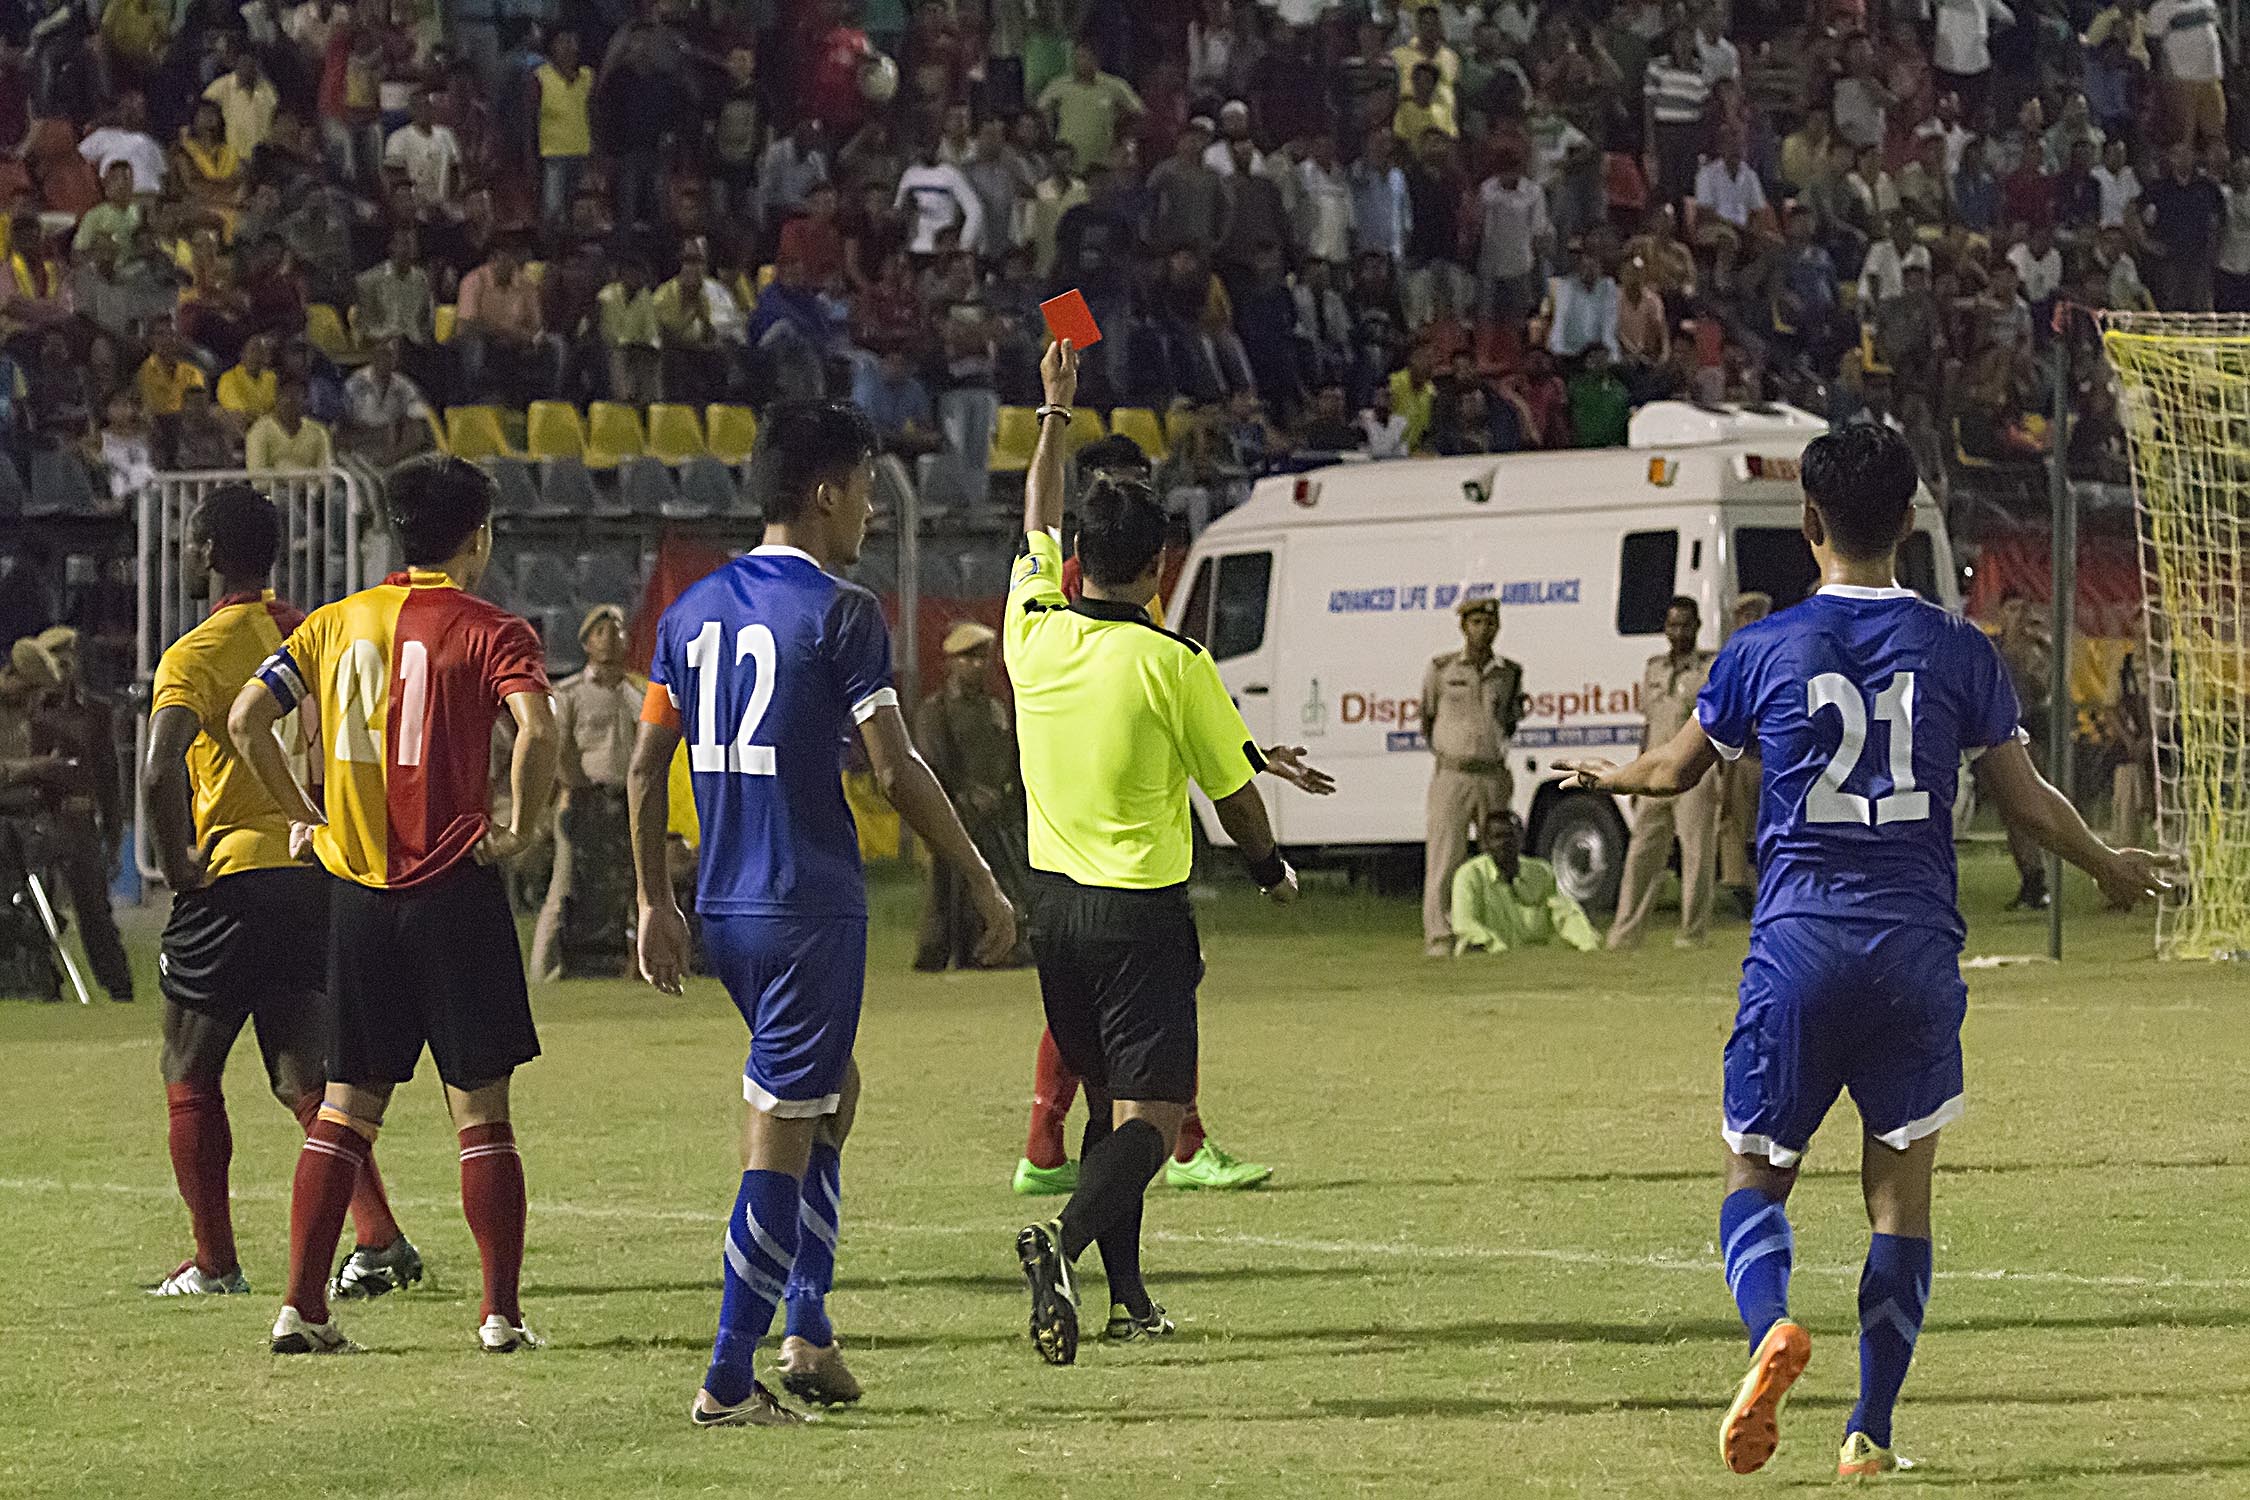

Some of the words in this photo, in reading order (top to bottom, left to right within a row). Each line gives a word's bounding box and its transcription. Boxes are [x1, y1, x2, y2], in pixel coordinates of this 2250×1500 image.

[1329, 587, 1396, 613] ADVANCED
[1400, 584, 1428, 610] LIFE
[1501, 578, 1581, 605] AMBULANCE
[687, 621, 776, 775] 12
[1342, 692, 1420, 730] Disp
[1521, 681, 1641, 723] ospital
[1806, 671, 1930, 826] 21
